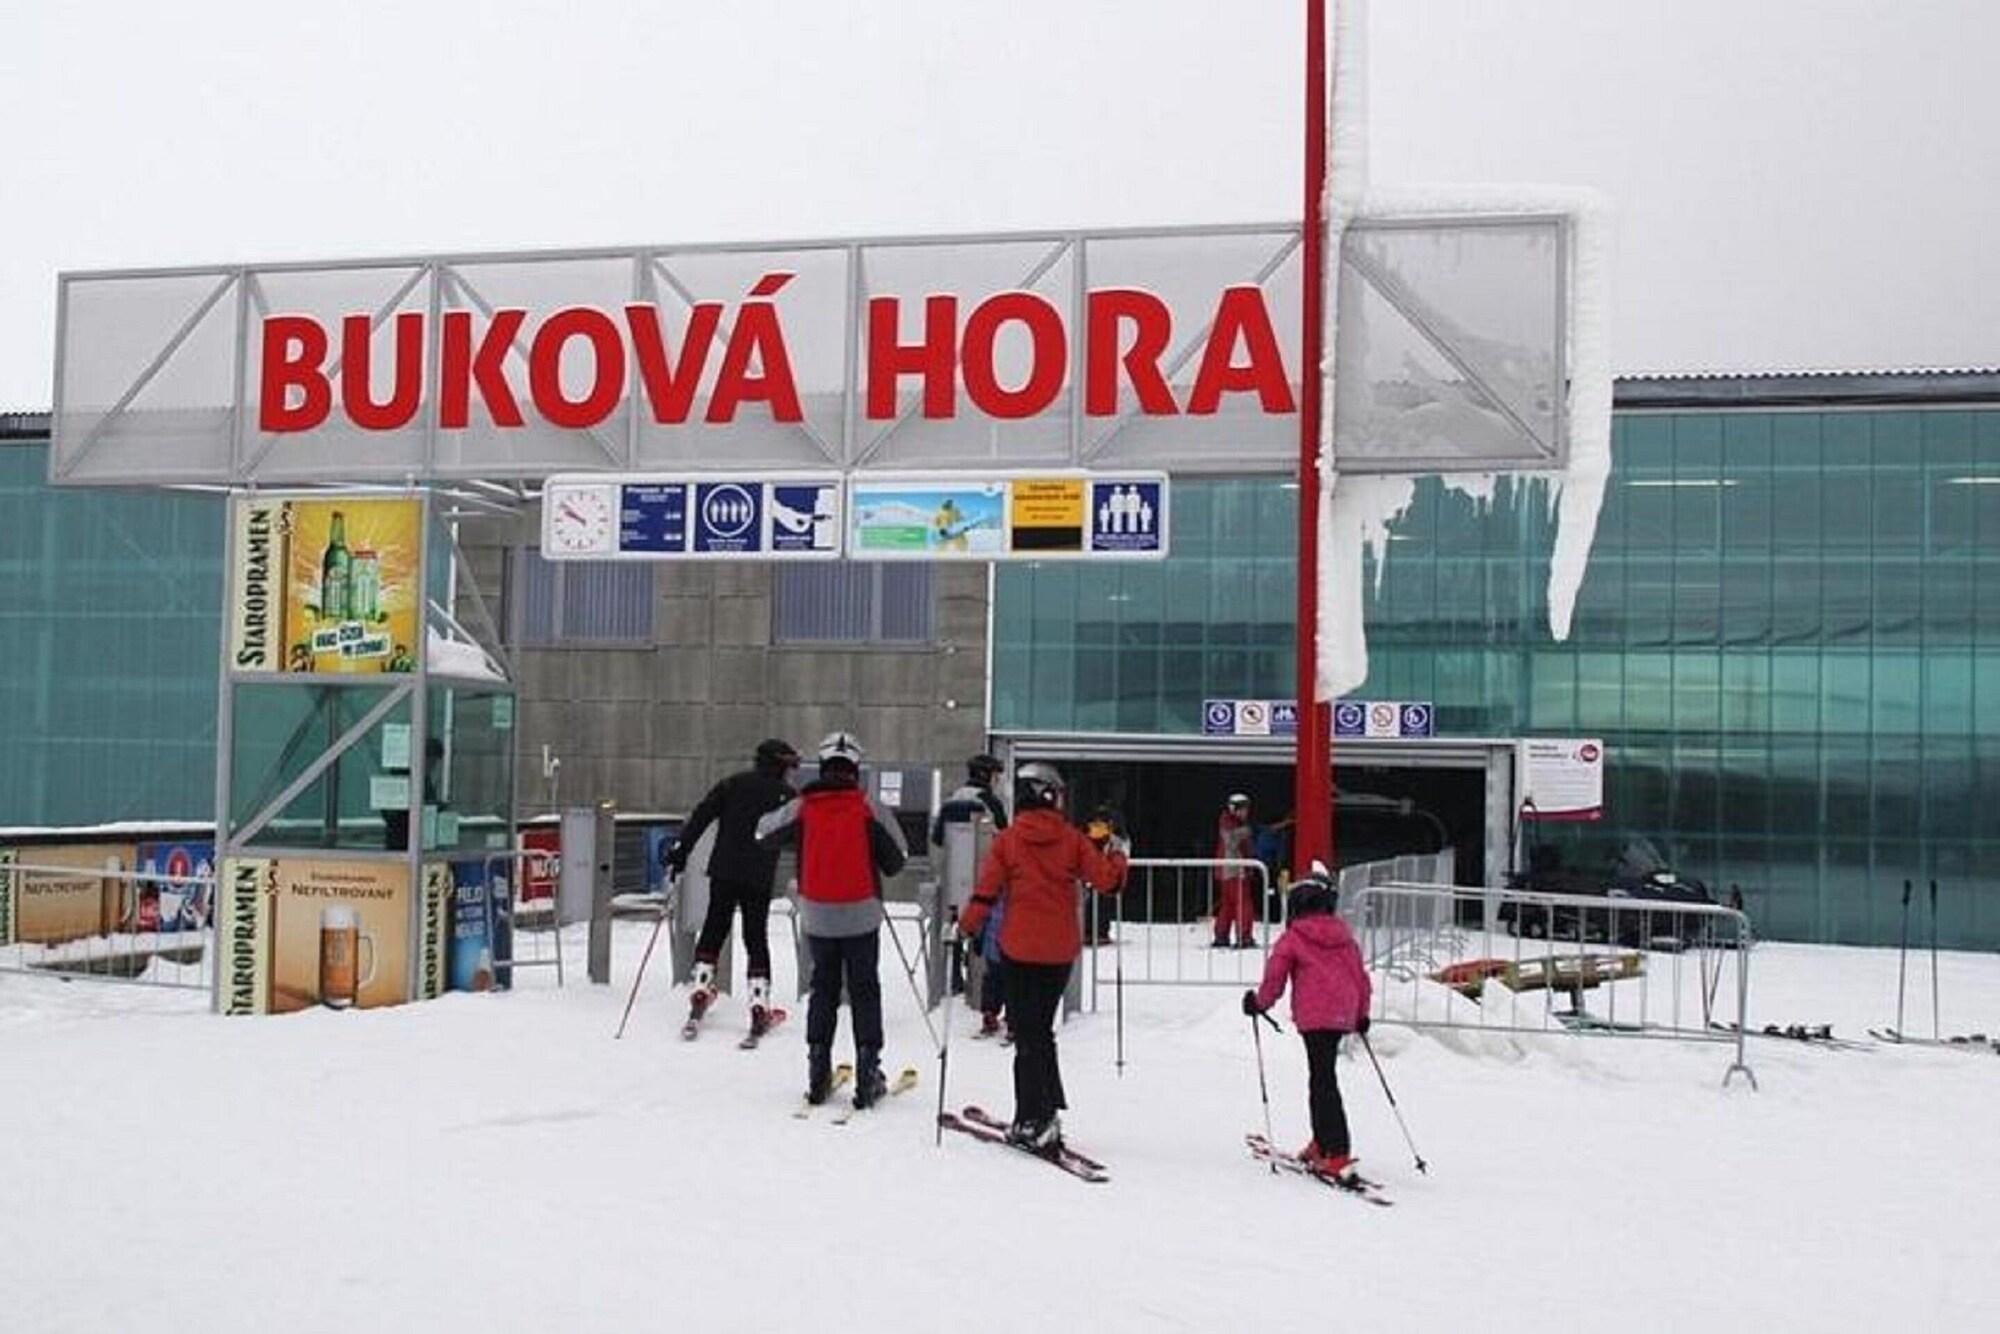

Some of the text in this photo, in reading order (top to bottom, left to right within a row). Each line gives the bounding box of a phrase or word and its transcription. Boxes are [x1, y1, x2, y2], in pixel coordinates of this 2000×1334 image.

[259, 273, 1297, 432] BUKOVÁ HORA
[237, 510, 270, 666] STAROPRAMEN
[424, 871, 440, 1000] ROPRAMEN
